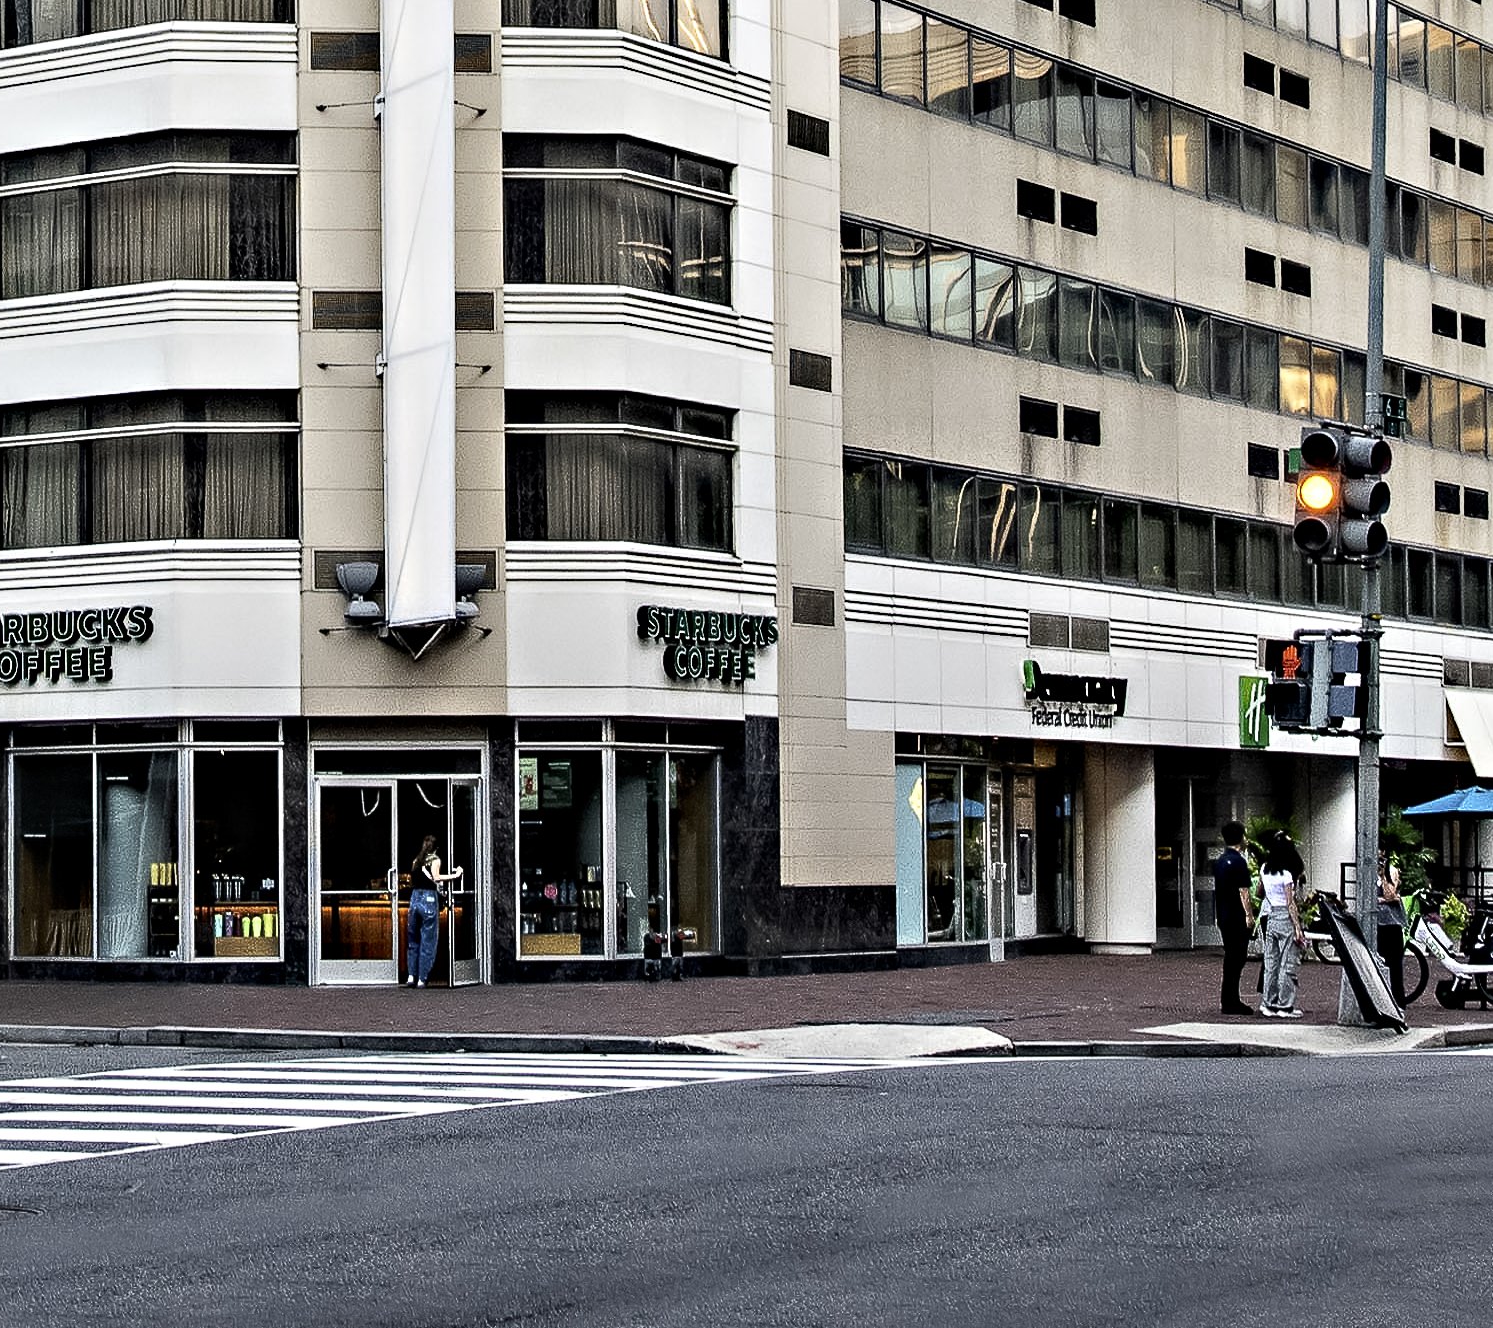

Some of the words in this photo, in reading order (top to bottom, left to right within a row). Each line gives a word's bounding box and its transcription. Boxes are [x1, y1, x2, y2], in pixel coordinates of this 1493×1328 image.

[638, 605, 779, 647] STARBUCKS
[671, 644, 756, 680] COFFEE
[1032, 706, 1062, 727] Federal
[1064, 708, 1088, 728] Credit
[1089, 709, 1113, 729] Union
